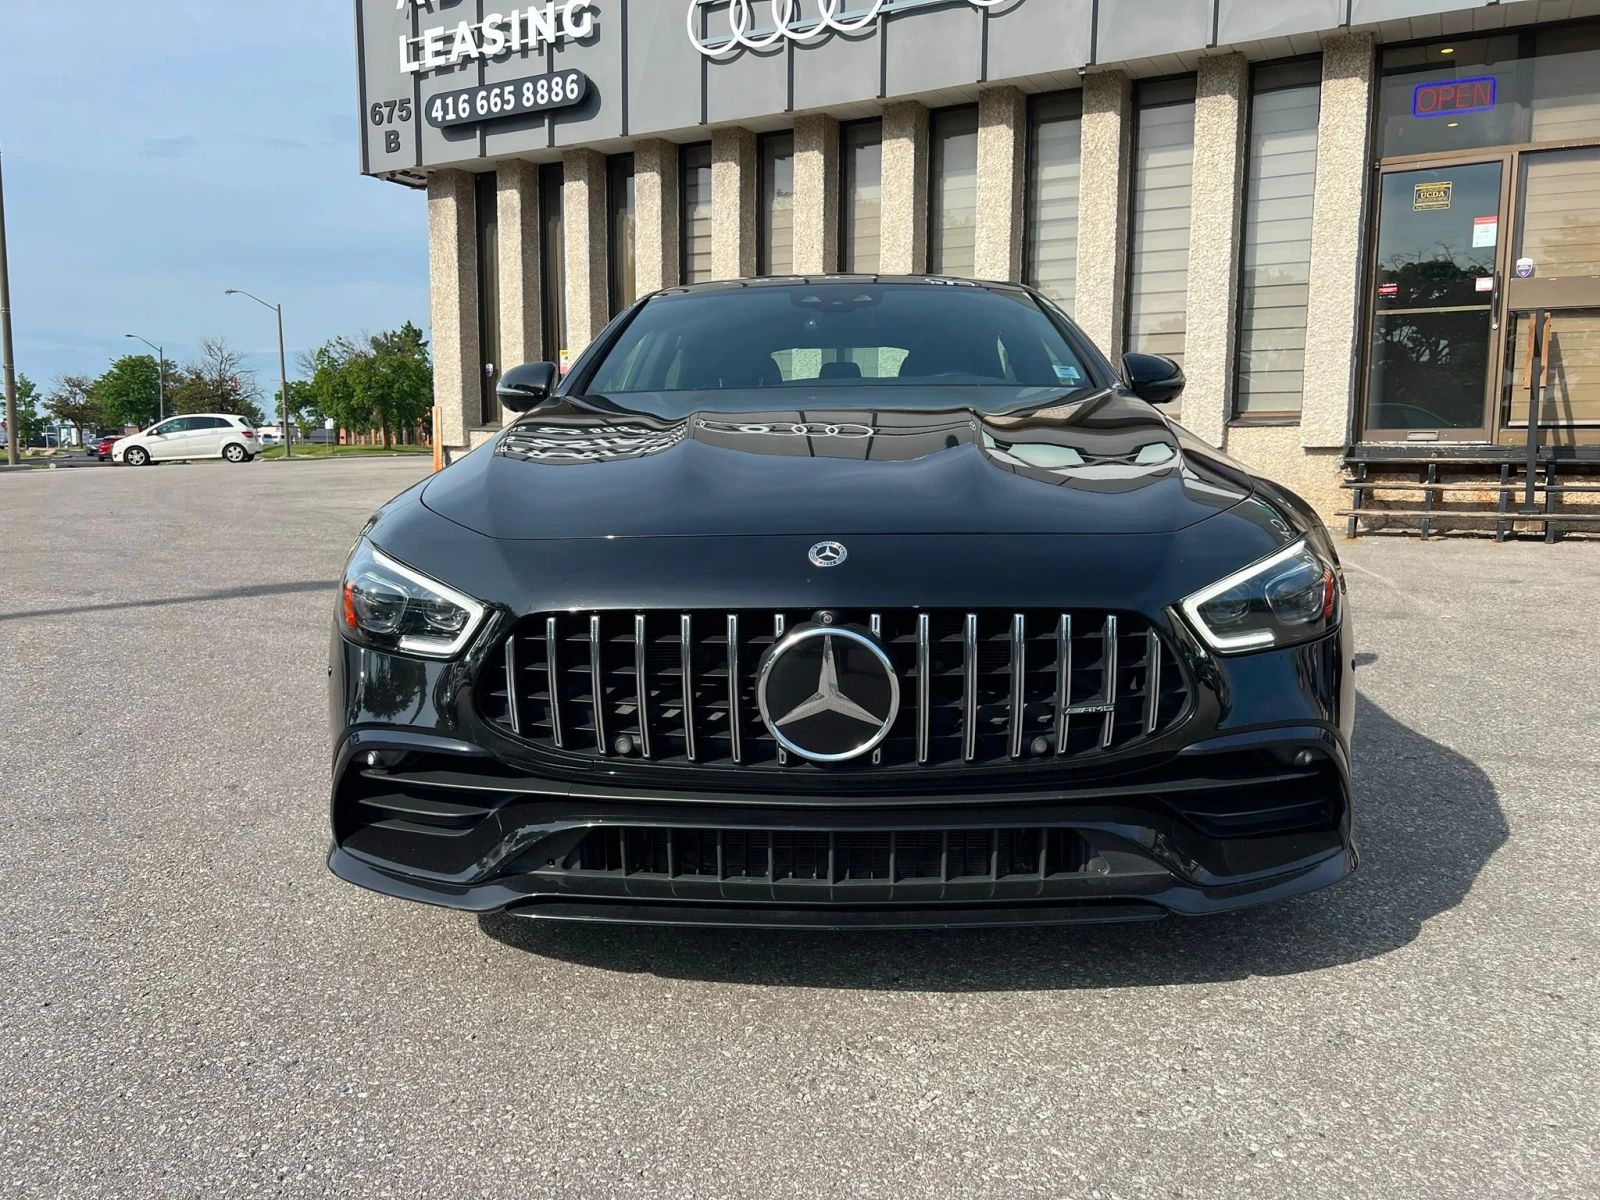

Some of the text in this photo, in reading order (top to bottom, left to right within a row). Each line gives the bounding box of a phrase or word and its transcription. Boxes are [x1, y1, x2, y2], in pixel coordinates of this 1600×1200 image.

[399, 0, 592, 73] LEASING
[370, 98, 411, 126] 675
[431, 74, 579, 122] 416 665 8886
[1416, 82, 1491, 113] OPEN
[384, 129, 400, 153] B
[1420, 190, 1445, 199] UCDA
